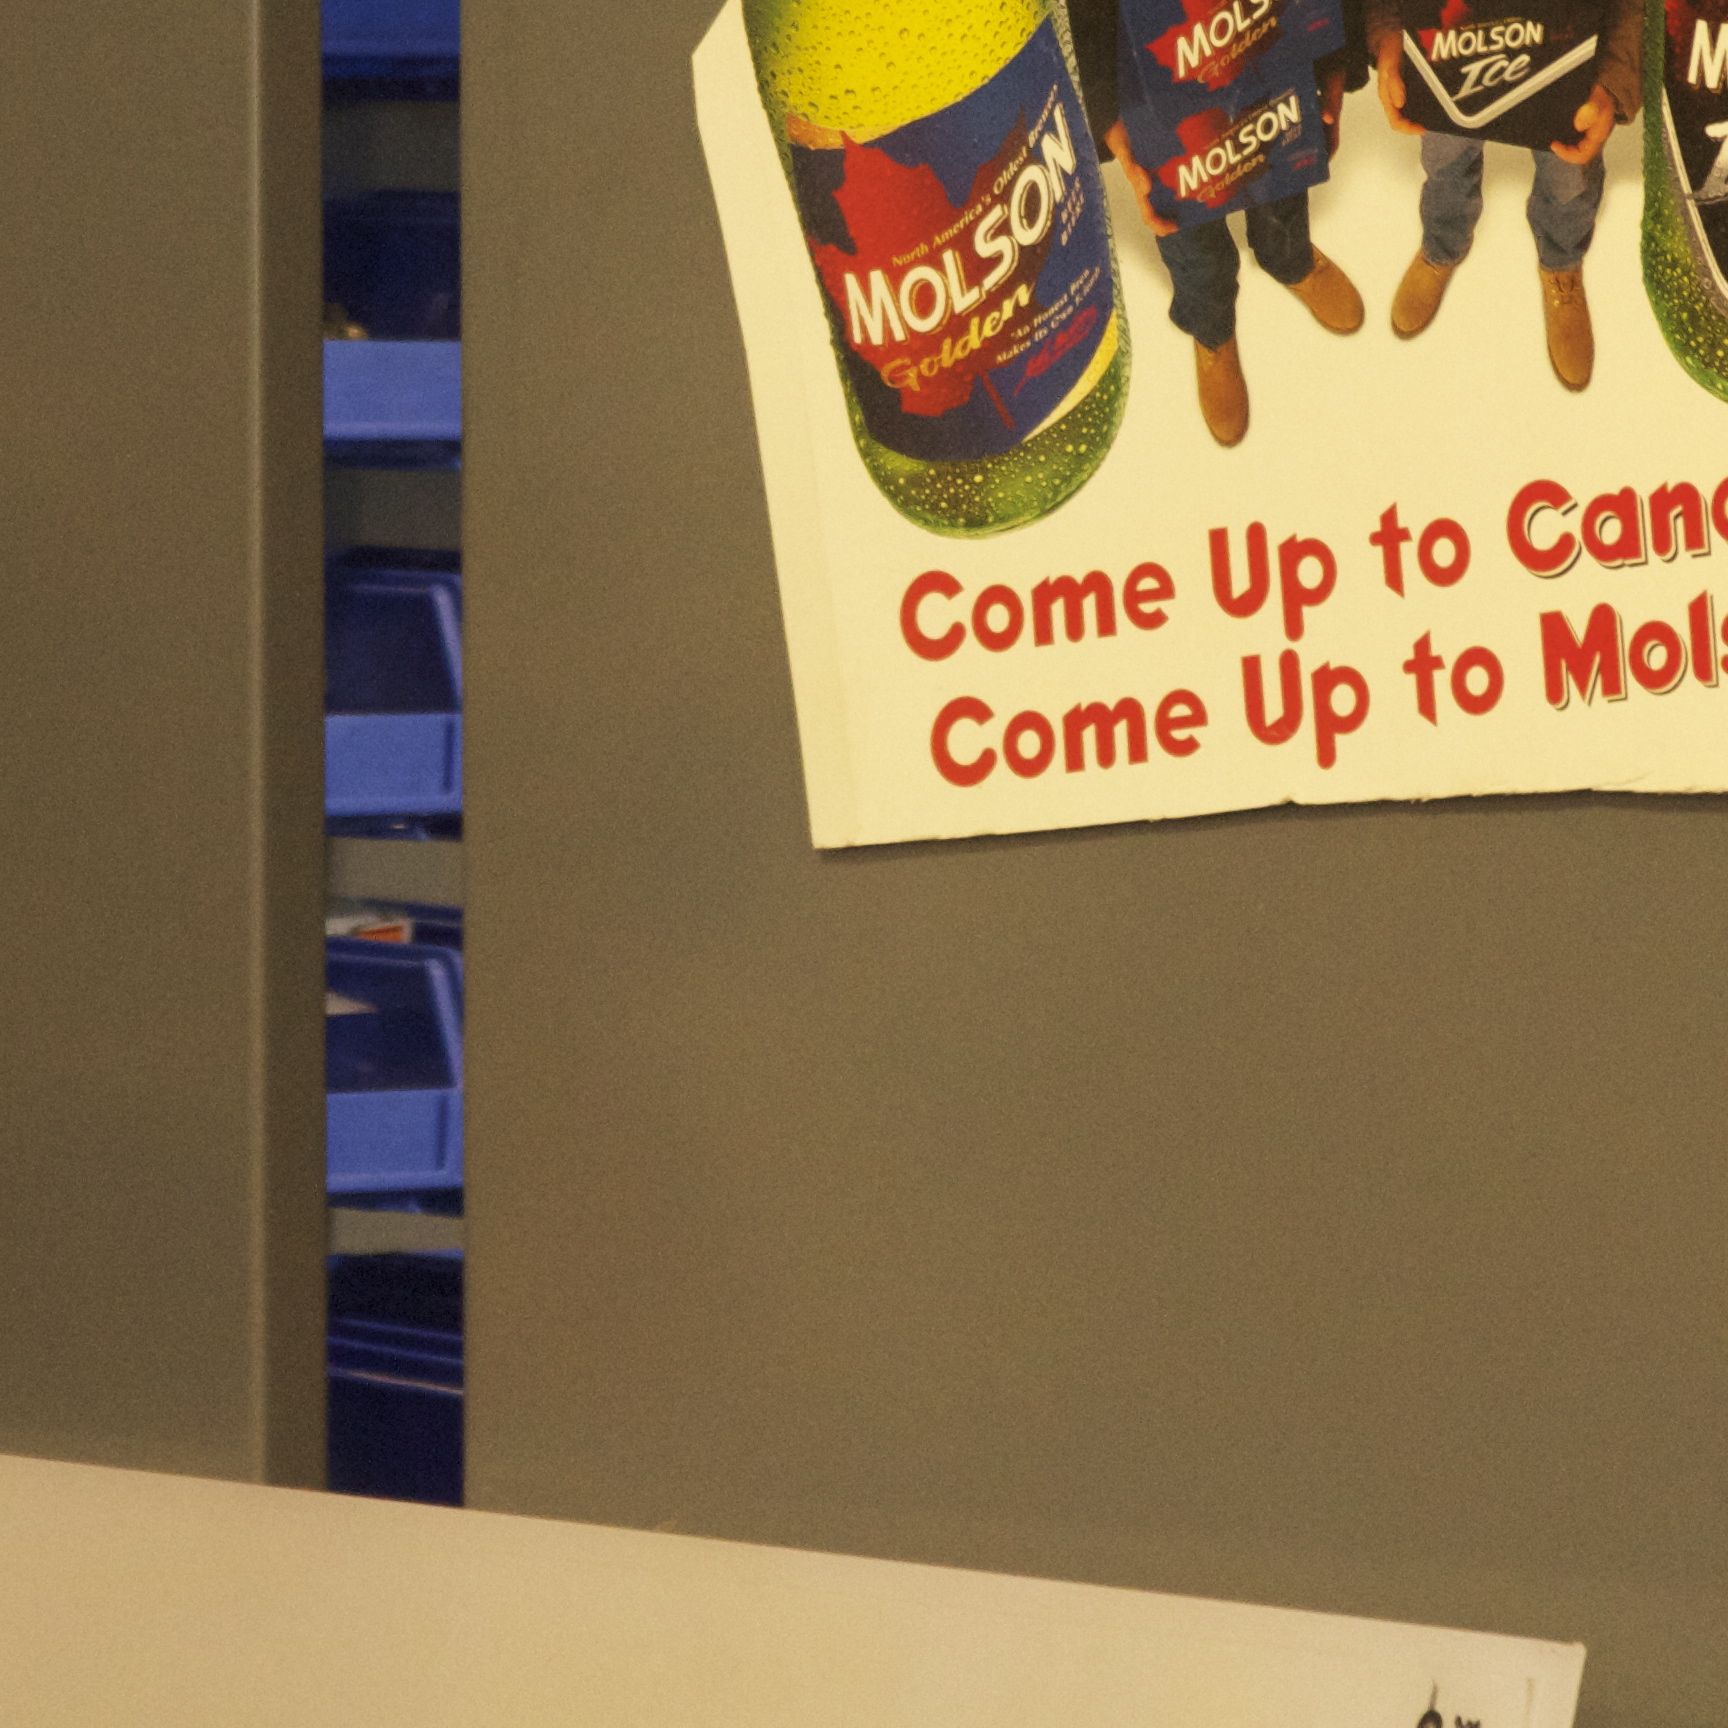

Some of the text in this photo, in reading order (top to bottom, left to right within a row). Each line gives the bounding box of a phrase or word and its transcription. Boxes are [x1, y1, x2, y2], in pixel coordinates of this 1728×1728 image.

[1430, 19, 1544, 63] MOLSON
[1450, 53, 1532, 102] Ice
[891, 241, 929, 268] North
[931, 192, 993, 253] America's
[992, 142, 1027, 197] Oldest
[1177, 94, 1303, 198] MOLSON
[843, 103, 1077, 348] MOLSON
[880, 279, 1037, 392] Golden
[900, 569, 1175, 661] Come
[1208, 520, 1338, 643] Up
[1368, 501, 1472, 598] to
[931, 688, 1209, 788] Come
[1241, 648, 1371, 769] Up
[1402, 629, 1506, 725] to
